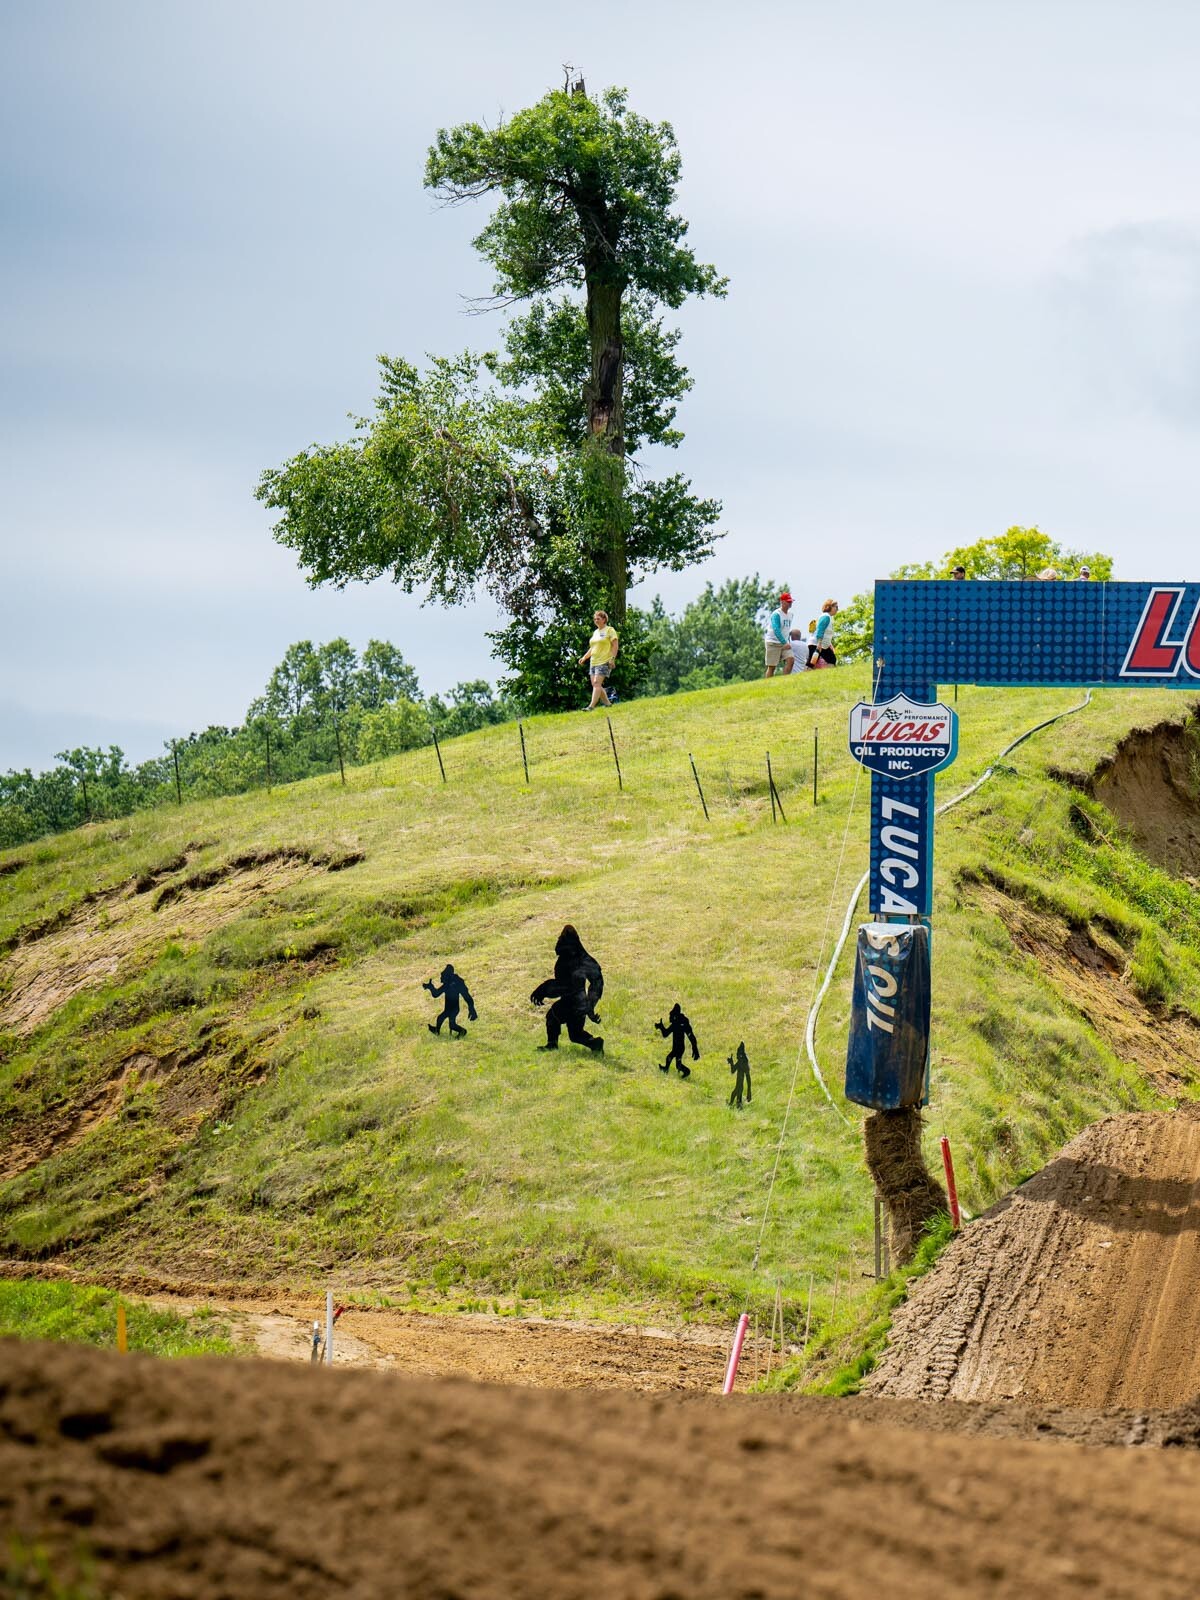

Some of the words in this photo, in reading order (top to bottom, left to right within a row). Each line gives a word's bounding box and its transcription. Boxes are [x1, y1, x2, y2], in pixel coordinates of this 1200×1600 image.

[860, 721, 946, 742] LUCAS
[854, 746, 876, 756] OIL
[880, 747, 946, 757] PRODUCTS
[888, 760, 913, 770] INC.
[866, 965, 898, 1034] OIL
